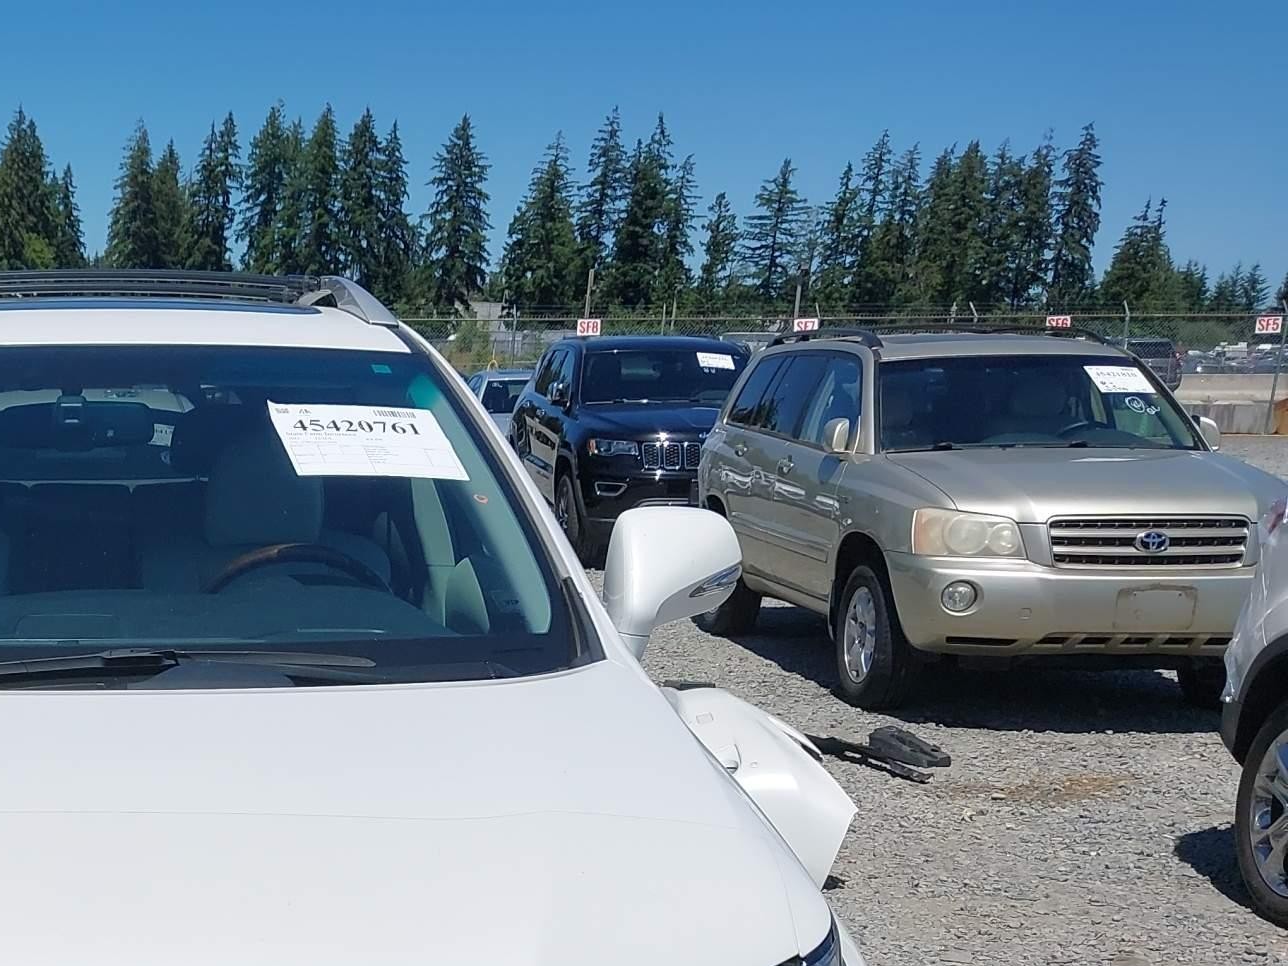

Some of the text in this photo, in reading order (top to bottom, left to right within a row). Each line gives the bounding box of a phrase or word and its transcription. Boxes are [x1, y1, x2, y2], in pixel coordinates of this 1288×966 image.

[579, 320, 599, 334] SF8
[1258, 317, 1281, 332] SF5
[293, 419, 421, 436] 45420761
